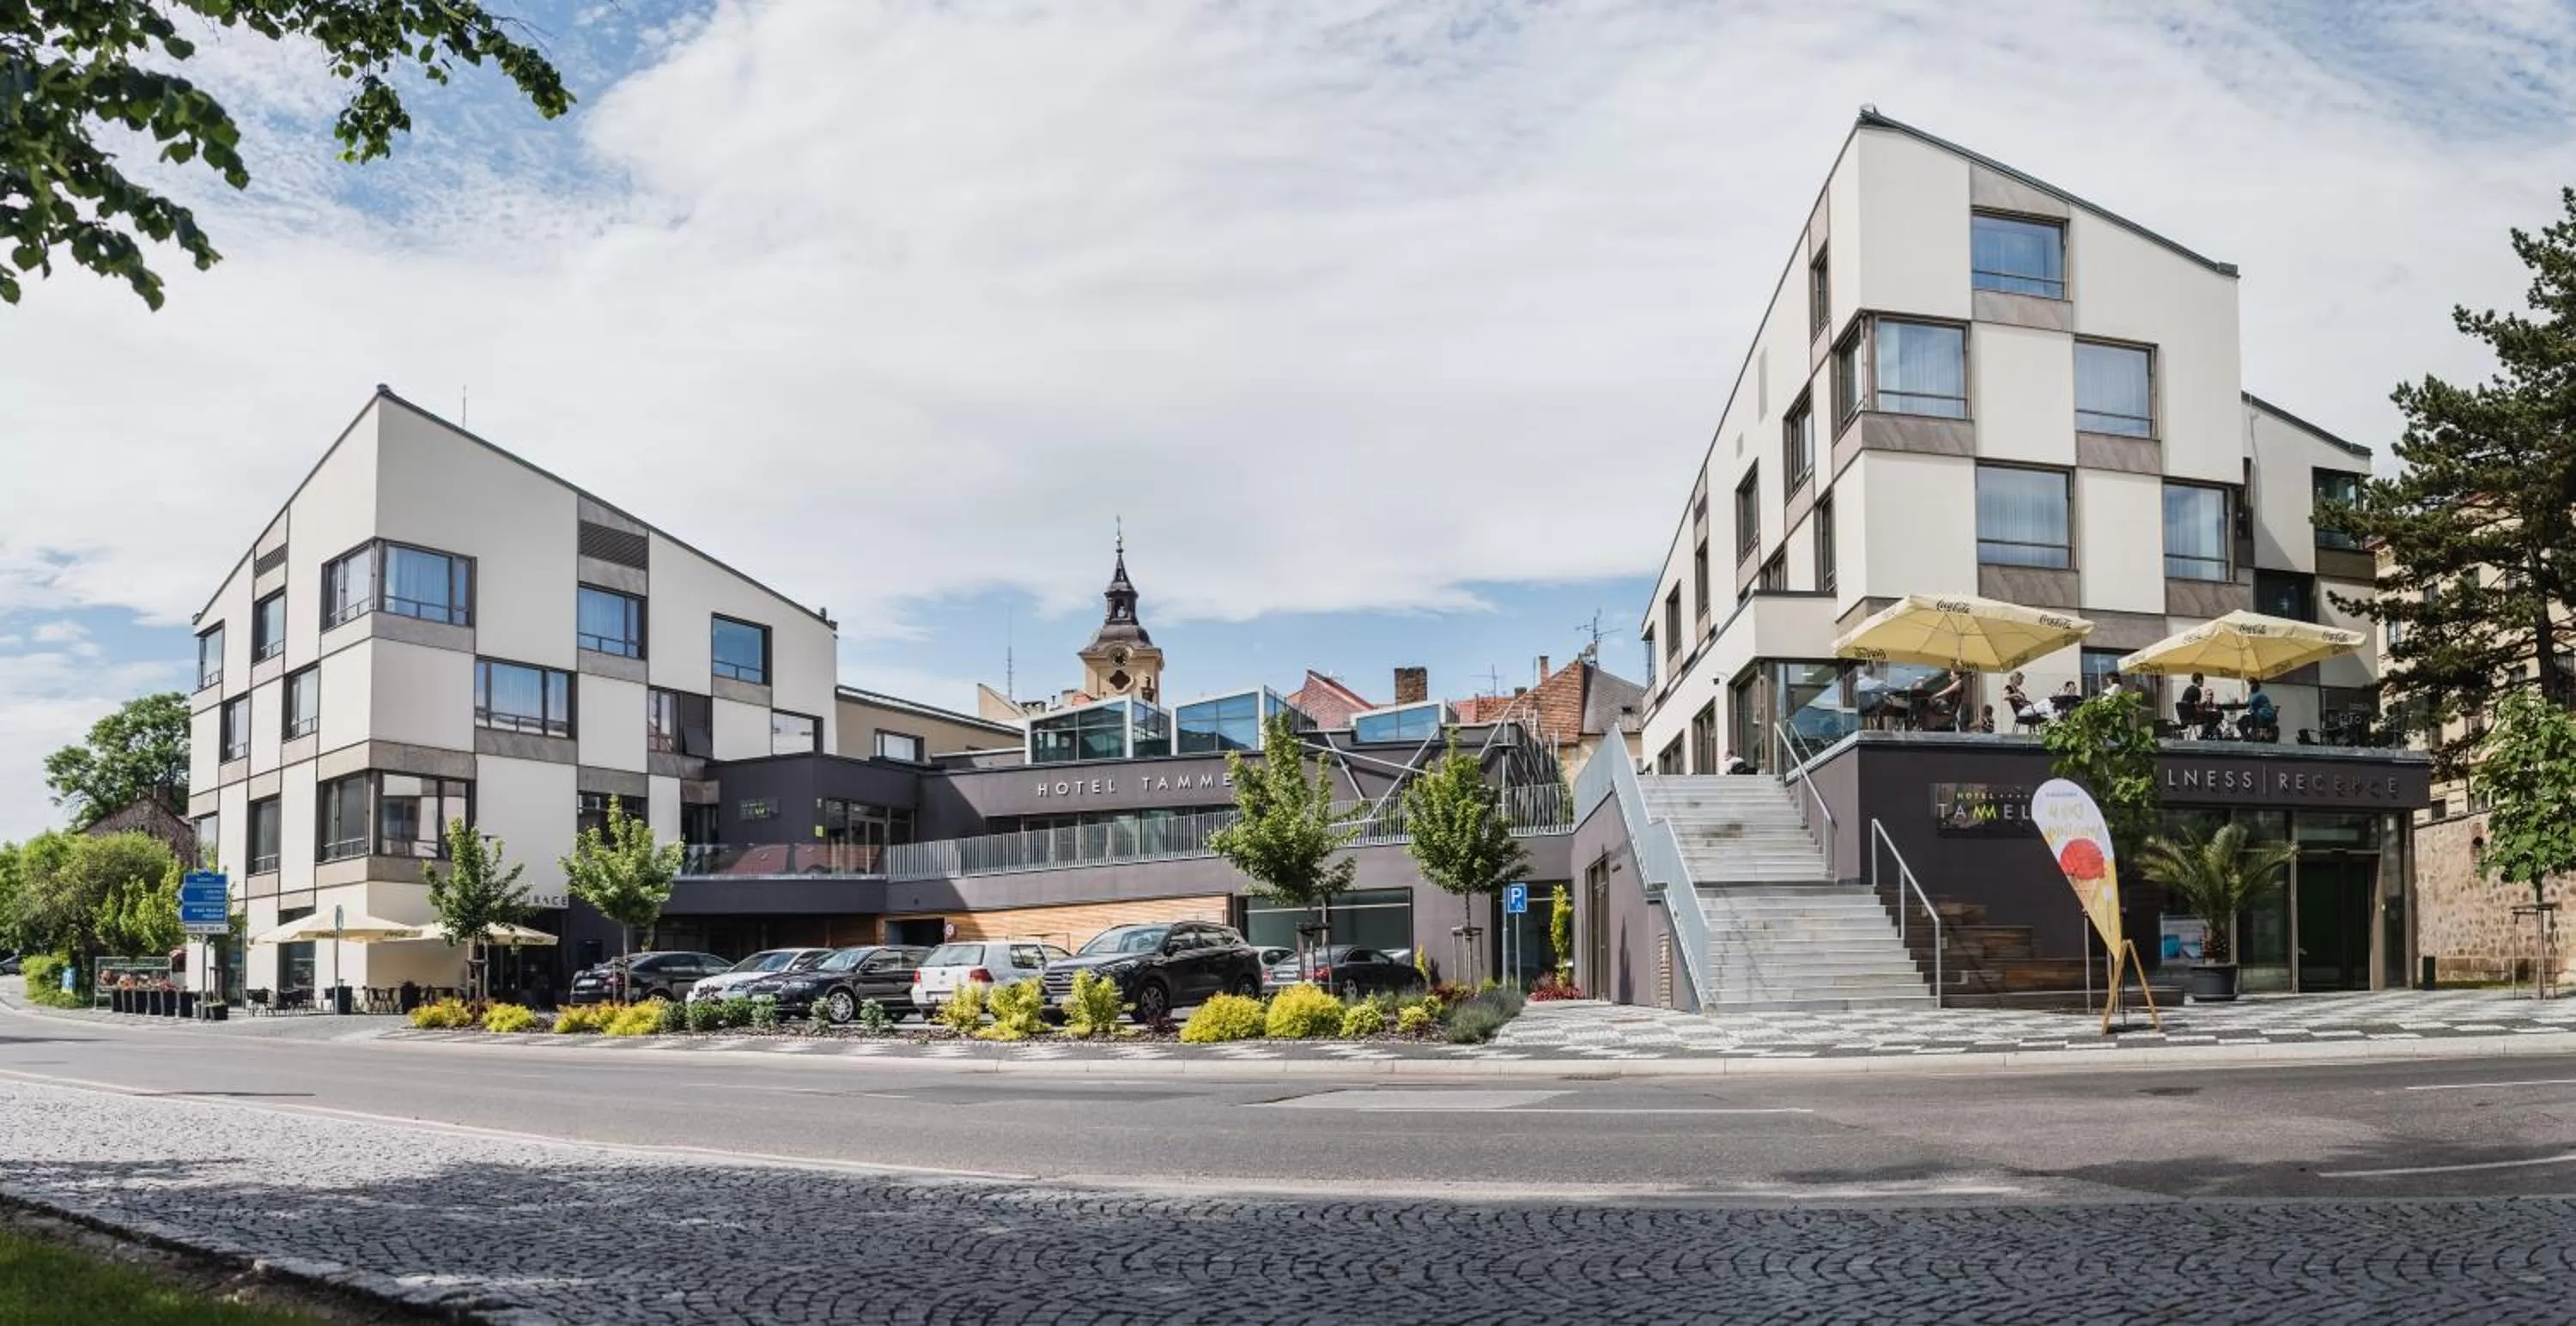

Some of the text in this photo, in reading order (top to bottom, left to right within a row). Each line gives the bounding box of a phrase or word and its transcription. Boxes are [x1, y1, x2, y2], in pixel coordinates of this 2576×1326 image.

[1037, 773, 1232, 797] HOTEL TAMME
[2167, 769, 2253, 788] LNESS
[1937, 803, 2030, 820] TAMMEL
[1511, 887, 1522, 904] P
